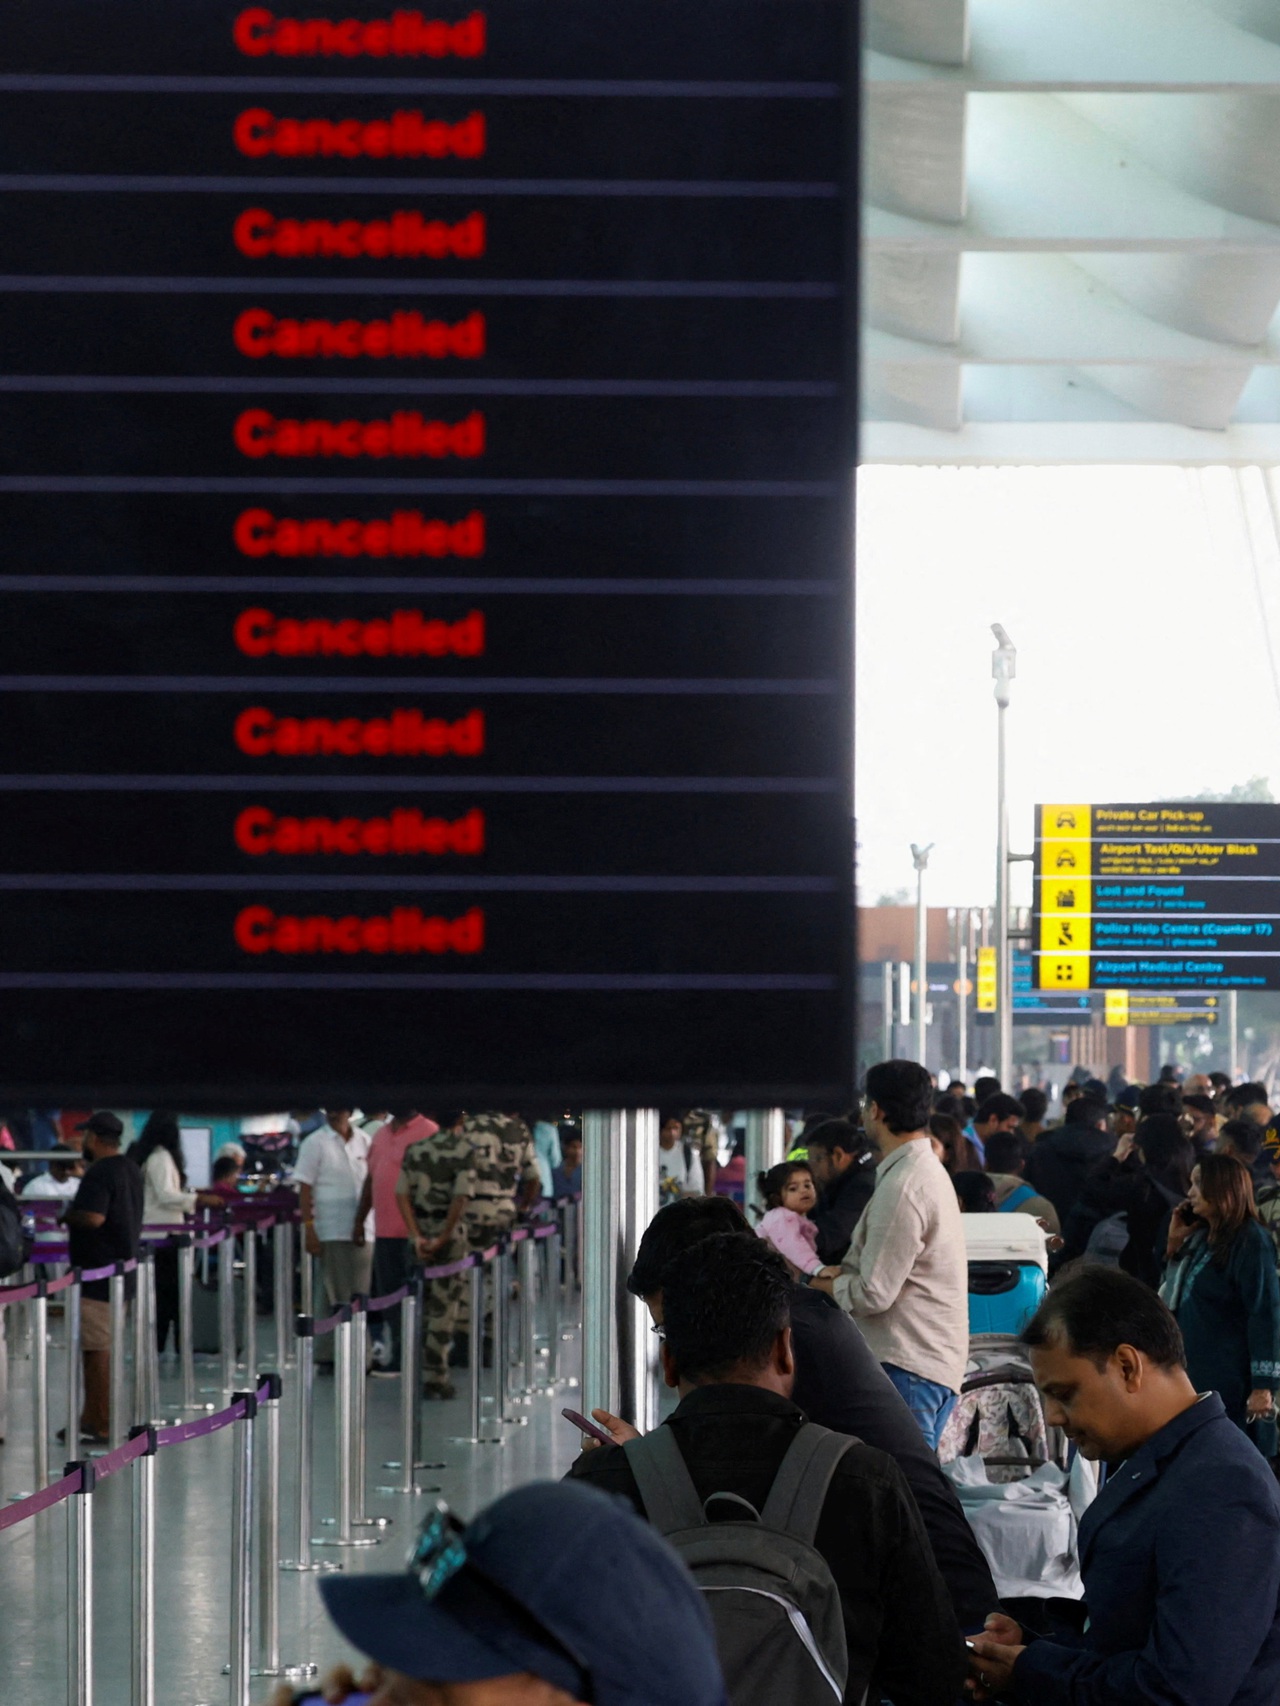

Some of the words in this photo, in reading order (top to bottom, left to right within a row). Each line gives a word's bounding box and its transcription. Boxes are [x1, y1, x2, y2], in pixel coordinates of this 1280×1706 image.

[234, 8, 485, 57] Cancelled
[234, 108, 485, 157] Cancelled
[234, 208, 485, 258] Cancelled
[234, 309, 485, 357] Cancelled
[234, 409, 485, 457] Cancelled
[234, 509, 485, 557] Cancelled
[234, 608, 485, 656] Cancelled
[234, 708, 485, 755] Cancelled
[234, 807, 485, 854] Cancelled
[1096, 809, 1136, 821] Private
[1137, 809, 1159, 821] Car
[1160, 810, 1204, 822] Pick-up
[1100, 843, 1142, 856] Airport
[1143, 843, 1225, 856] Taxi/Ola/Uber
[1226, 844, 1258, 856] Black
[1095, 885, 1122, 897] Lost
[1123, 885, 1146, 897] and
[1147, 885, 1185, 897] Found
[234, 906, 485, 953] Cancelled
[1095, 922, 1131, 935] Police
[1132, 922, 1160, 936] Help
[1161, 922, 1200, 935] Centre
[1201, 922, 1253, 936] (Counter
[1095, 961, 1137, 974] Airport
[1138, 961, 1184, 973] Medical
[1185, 961, 1224, 973] Centre
